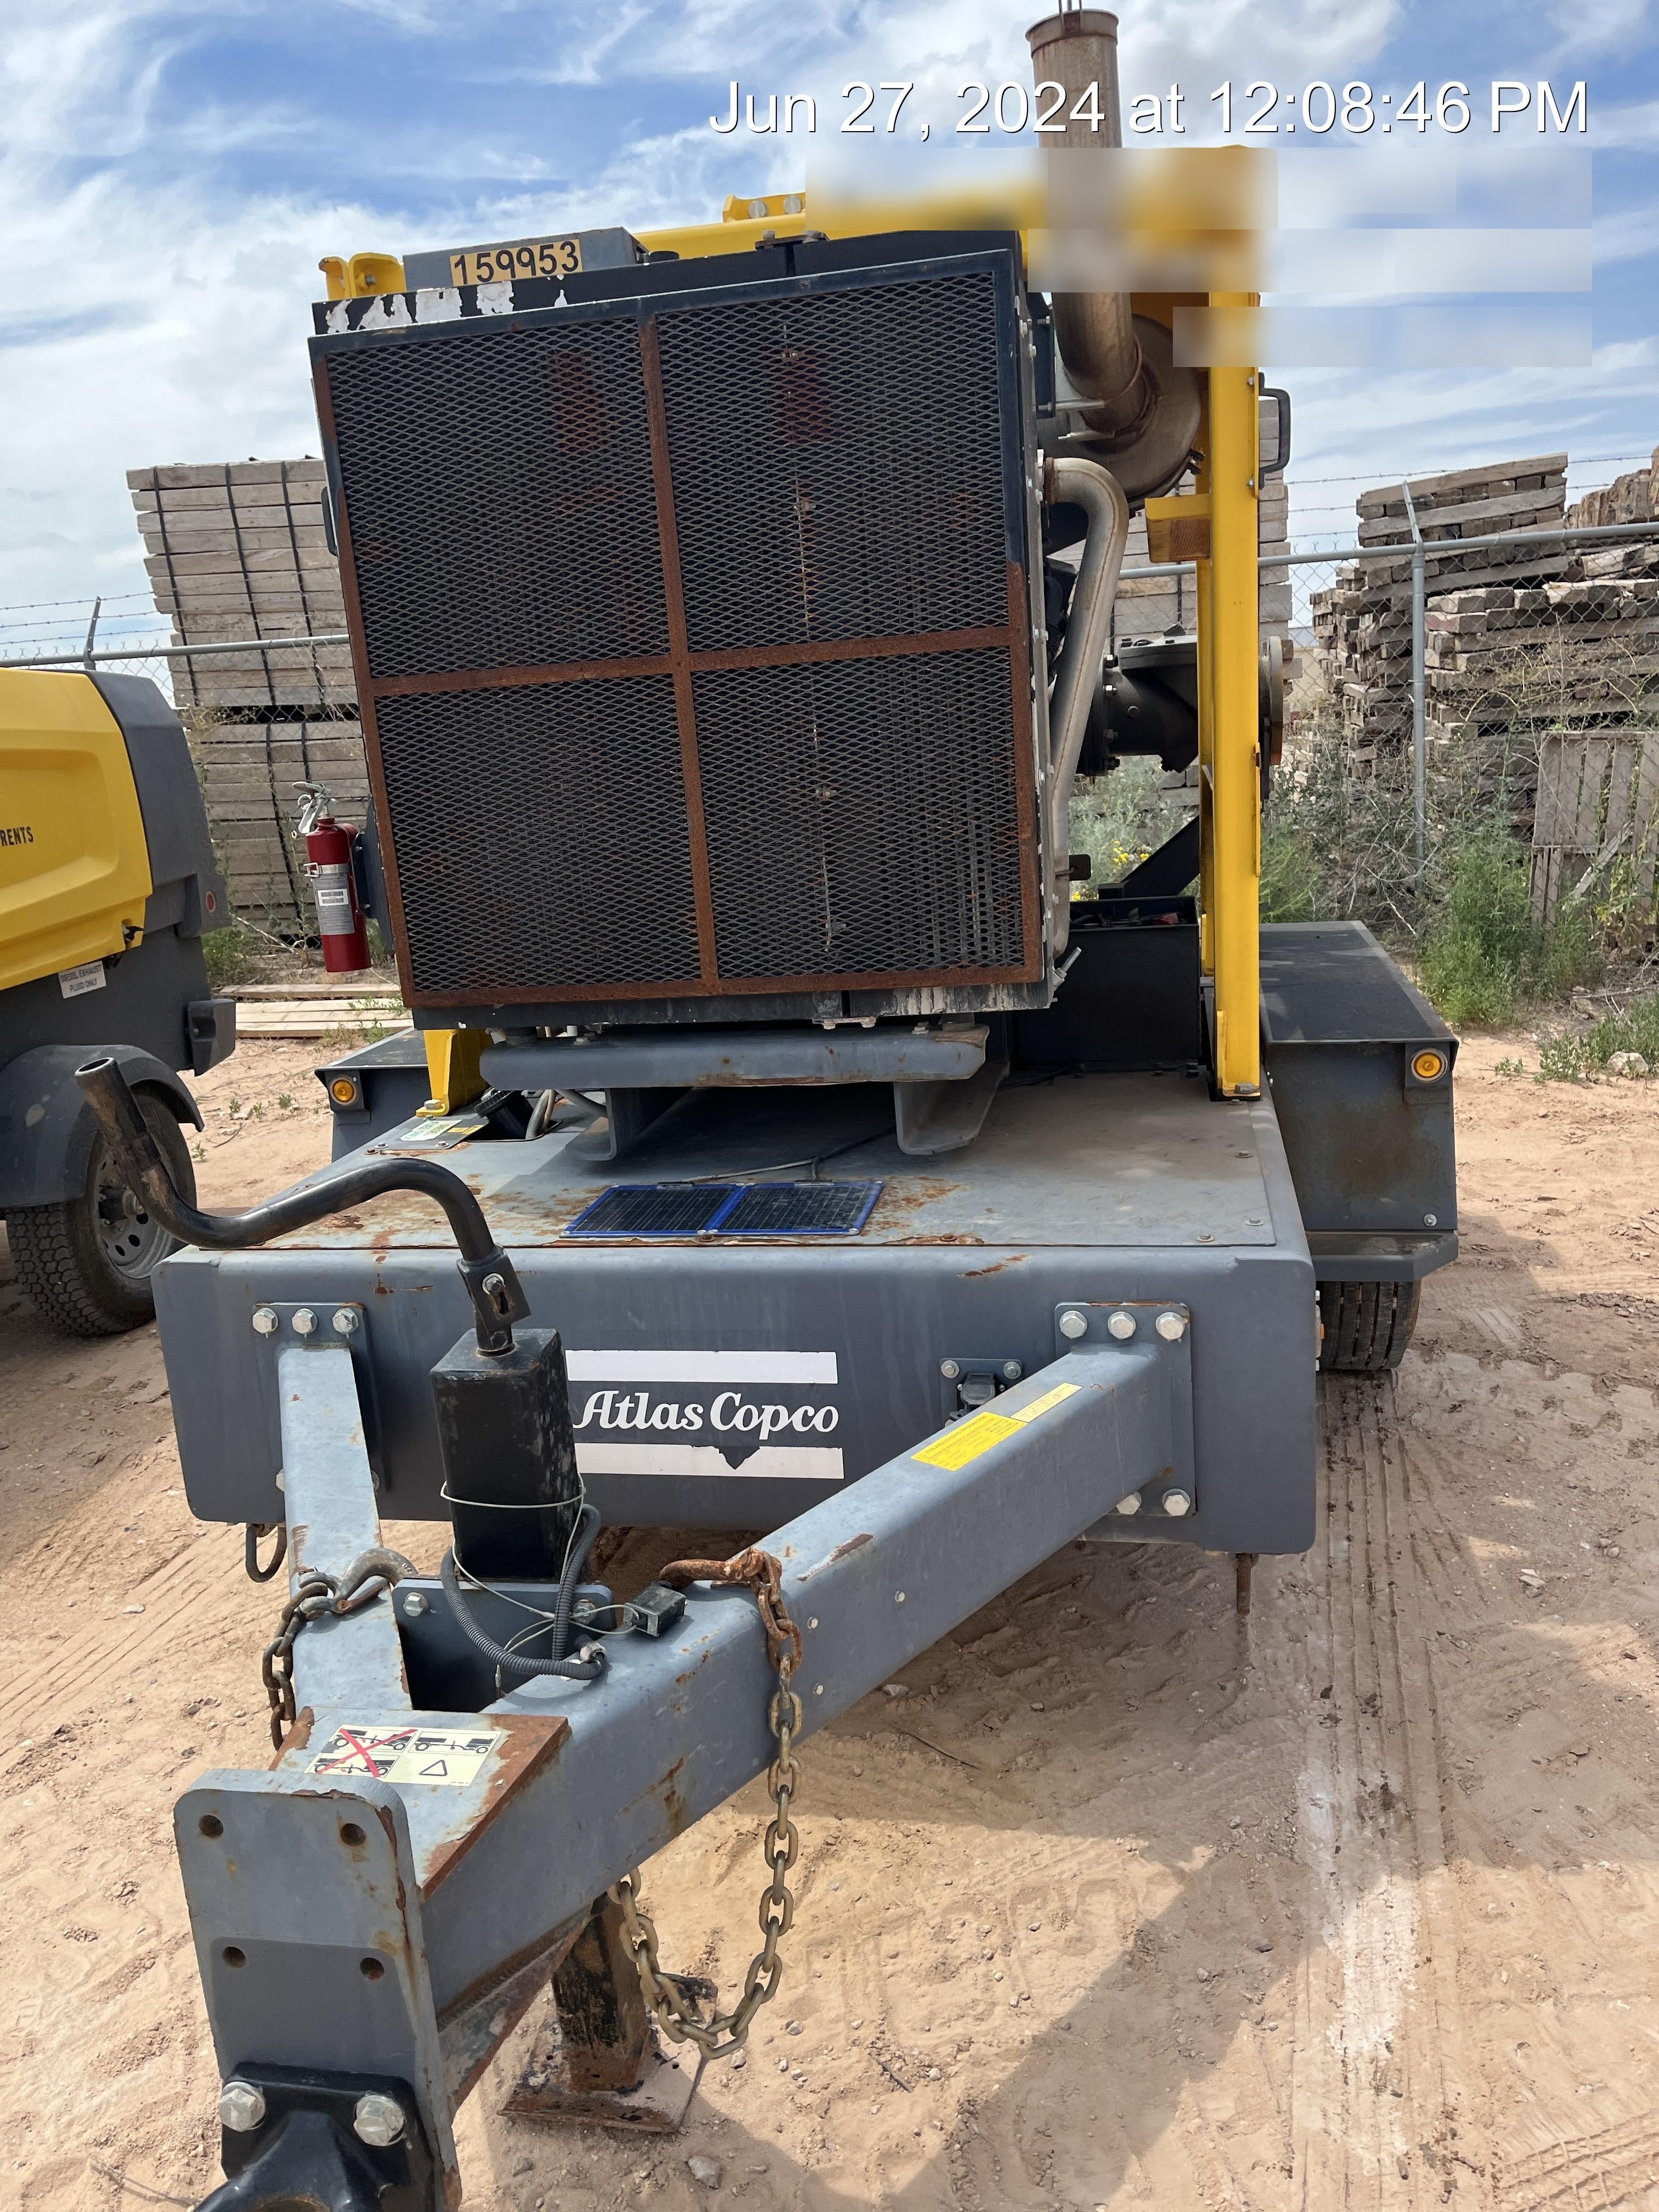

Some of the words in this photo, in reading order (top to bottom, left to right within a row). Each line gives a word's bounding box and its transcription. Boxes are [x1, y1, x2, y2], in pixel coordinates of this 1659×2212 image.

[454, 241, 579, 285] 159953
[572, 1390, 704, 1431] Atlas
[709, 1392, 839, 1440] Copco
